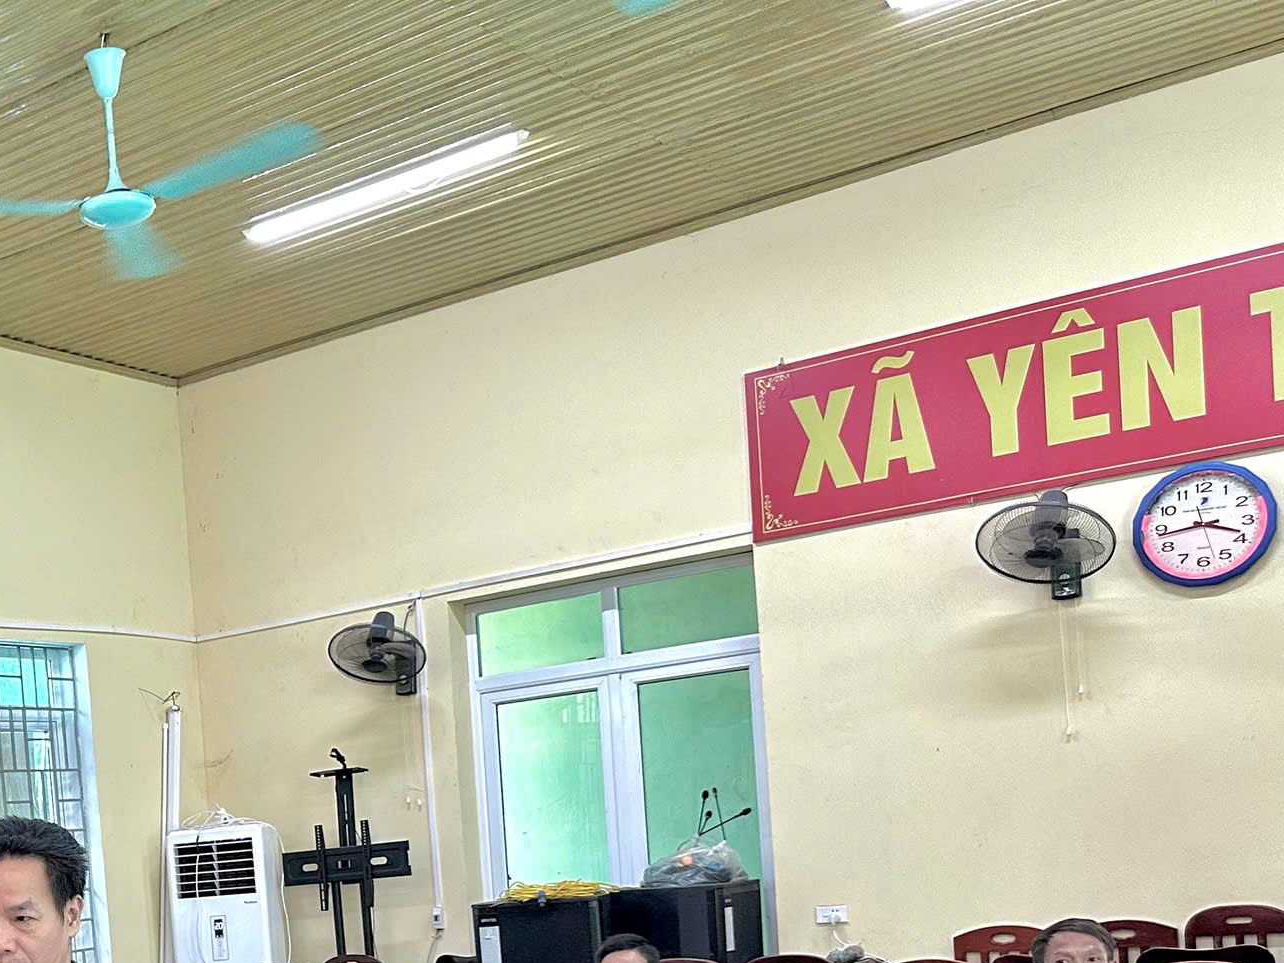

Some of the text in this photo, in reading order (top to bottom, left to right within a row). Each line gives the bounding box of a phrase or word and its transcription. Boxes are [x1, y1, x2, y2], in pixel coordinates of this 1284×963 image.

[789, 350, 936, 497] XÃ
[966, 305, 1207, 457] YÊN
[1195, 481, 1213, 494] 12
[1223, 484, 1228, 495] 1
[1176, 489, 1188, 501] 11
[1235, 496, 1249, 507] 2
[1160, 505, 1177, 516] 10
[1241, 514, 1255, 525] 3
[1155, 524, 1168, 537] 9
[1233, 533, 1248, 544] 4
[1161, 541, 1175, 552] 8
[1177, 553, 1189, 564] 7
[1218, 549, 1232, 560] 5
[1196, 556, 1211, 567] 6
